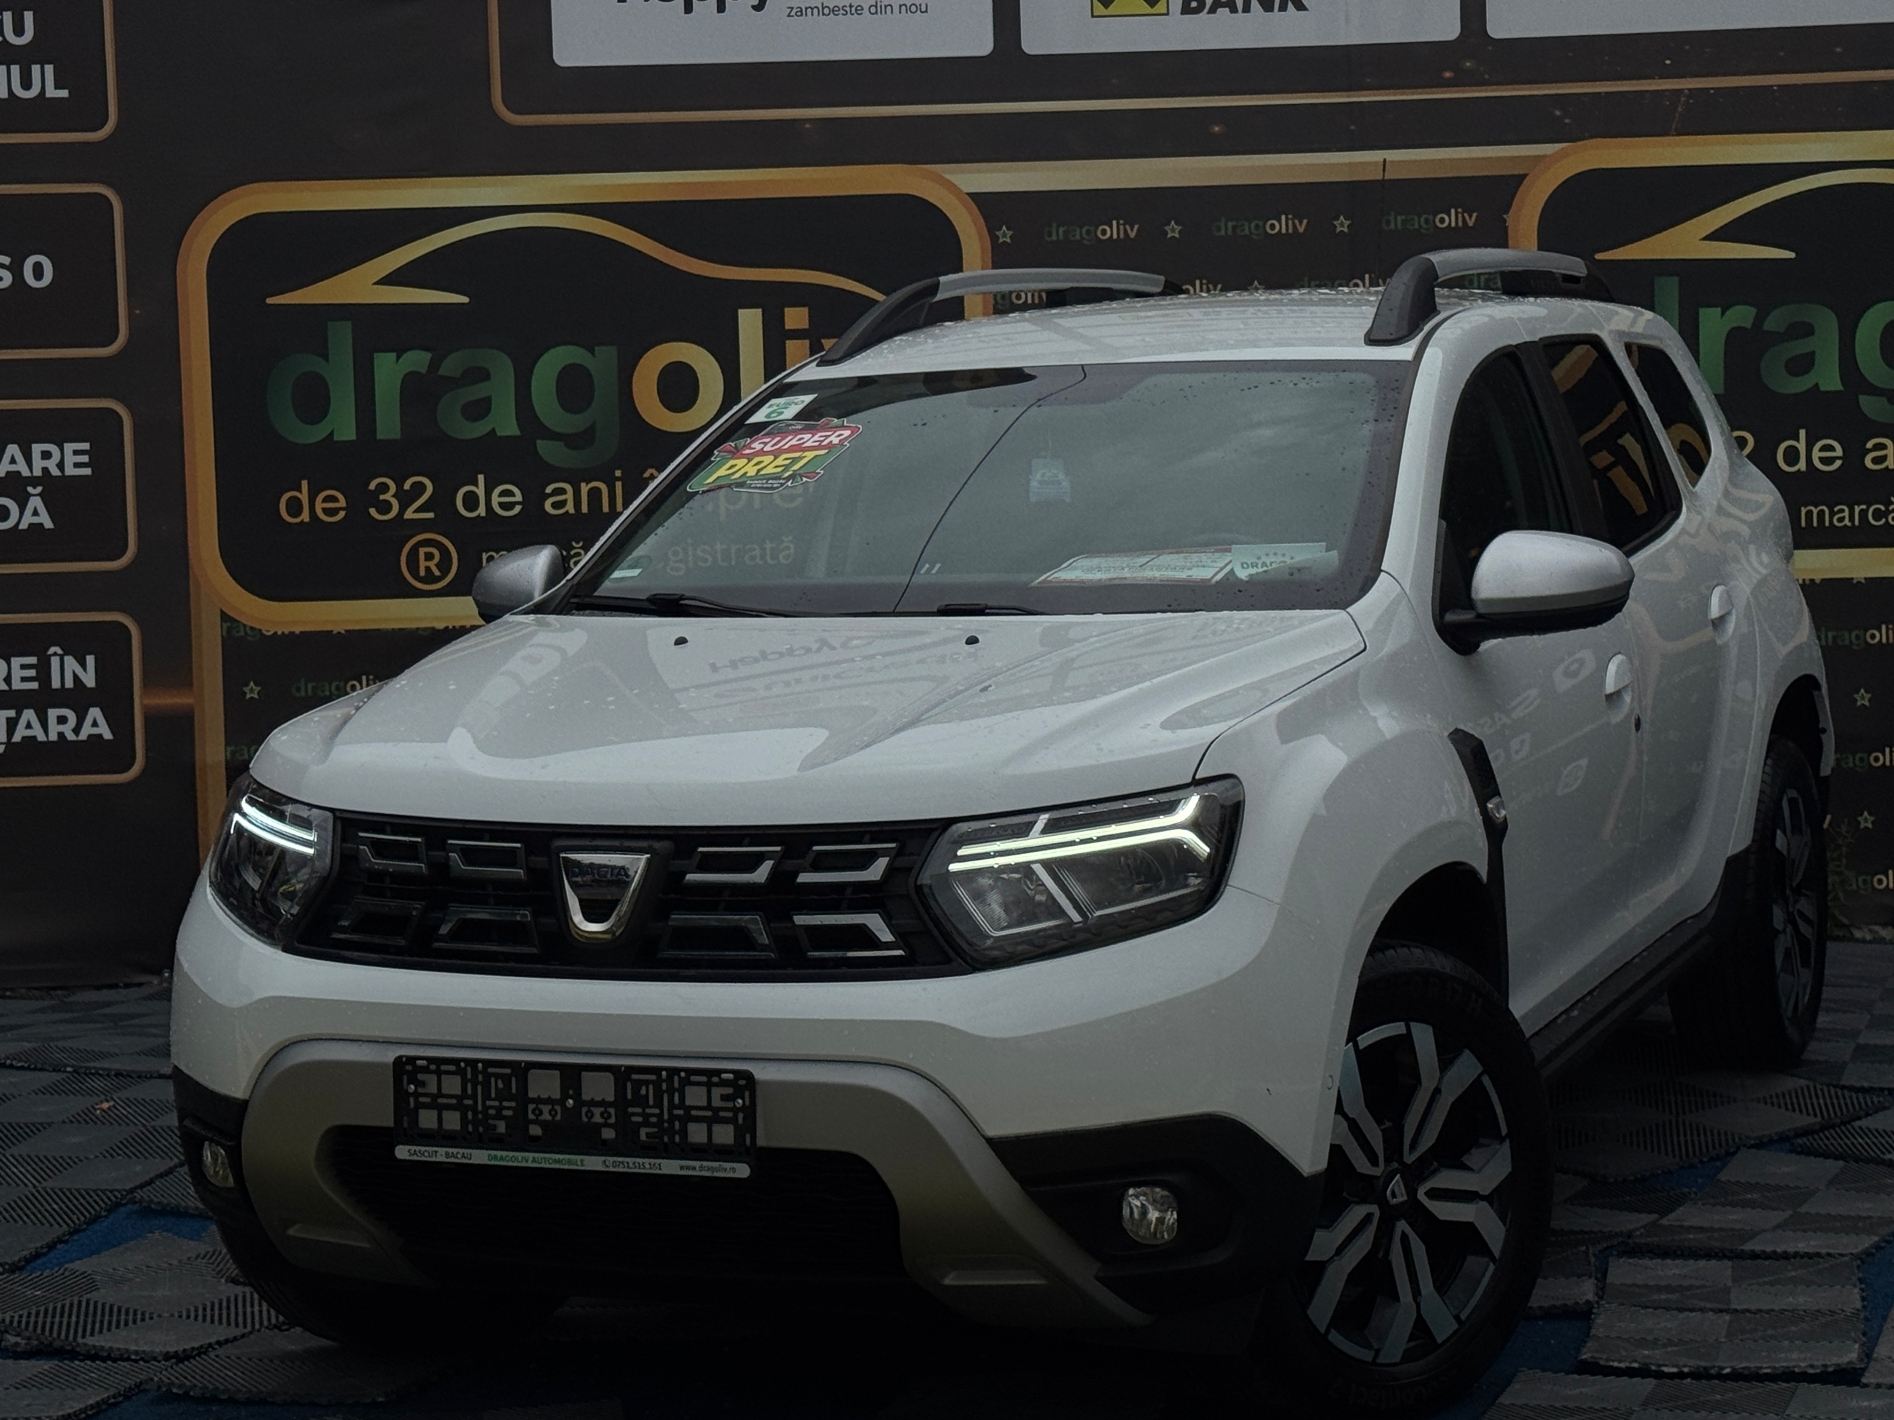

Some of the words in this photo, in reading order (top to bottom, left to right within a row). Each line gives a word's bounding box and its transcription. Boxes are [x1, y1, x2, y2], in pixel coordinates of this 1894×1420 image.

[786, 1, 864, 18] zambeste
[868, 1, 894, 16] din
[899, 3, 929, 15] nou
[0, 10, 35, 46] U
[1044, 219, 1139, 245] dragoliv
[1212, 213, 1309, 240] dragoliv
[1382, 207, 1478, 235] dragoliv
[266, 307, 839, 469] dragoli
[764, 407, 790, 419] 6
[742, 429, 852, 454] SUPER
[1776, 428, 1845, 473] de
[279, 479, 347, 524] de
[368, 475, 436, 521] 32
[455, 474, 524, 519] de
[543, 469, 624, 516] ani
[46, 645, 97, 690] ÎN
[407, 1148, 439, 1159] SASCUT
[487, 1153, 529, 1164] DRAGOLIV
[531, 1156, 585, 1168] AUTOMOBILE
